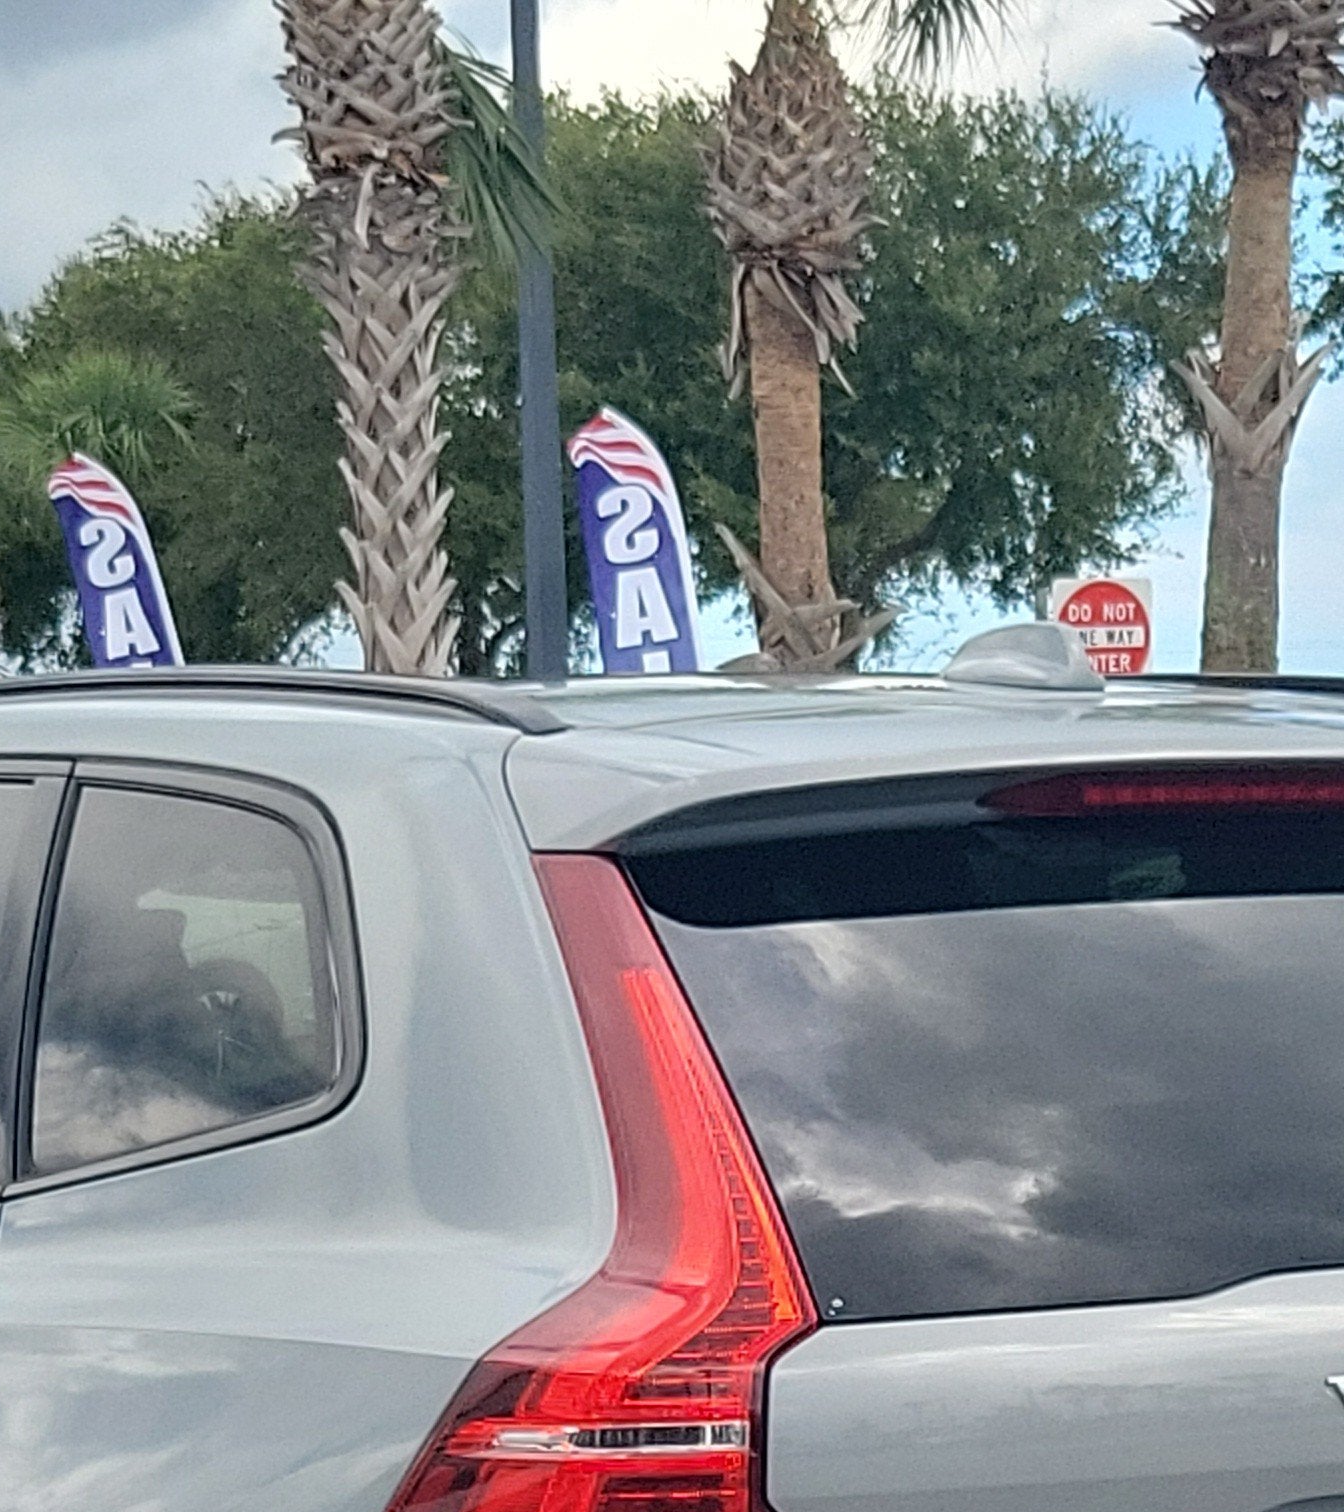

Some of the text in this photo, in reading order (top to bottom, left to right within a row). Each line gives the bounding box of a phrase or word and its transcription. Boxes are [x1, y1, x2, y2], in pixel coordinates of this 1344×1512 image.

[1067, 602, 1136, 623] DO NOT
[1078, 629, 1134, 646] NE WAY
[1088, 652, 1132, 674] NTER
